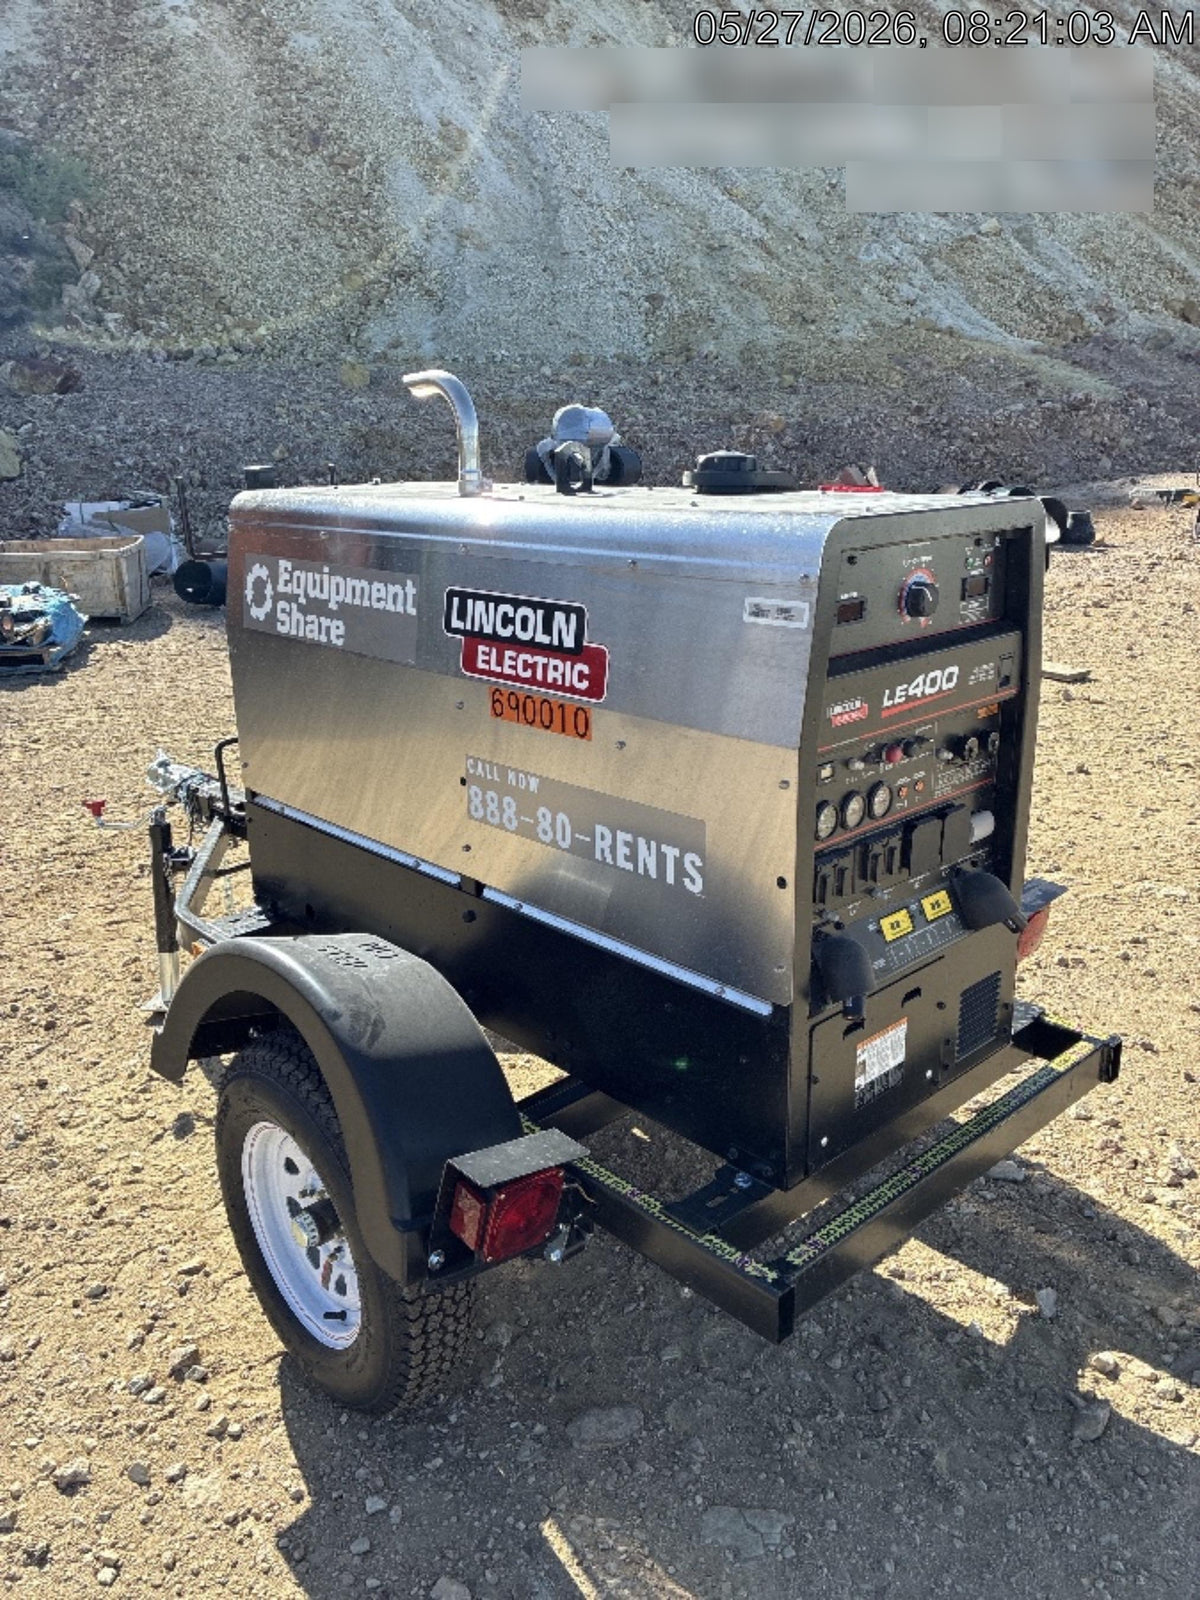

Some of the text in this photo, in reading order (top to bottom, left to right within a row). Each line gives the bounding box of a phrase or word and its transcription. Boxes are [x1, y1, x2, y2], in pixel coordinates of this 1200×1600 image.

[277, 559, 417, 617] Equipment
[276, 600, 345, 647] Share
[450, 596, 577, 649] LINCOLN
[475, 644, 590, 691] ELECTRIC
[882, 665, 960, 708] LE400
[491, 687, 590, 738] 690010
[466, 757, 540, 793] CALL NOW
[468, 784, 704, 895] 888-80-RENTS
